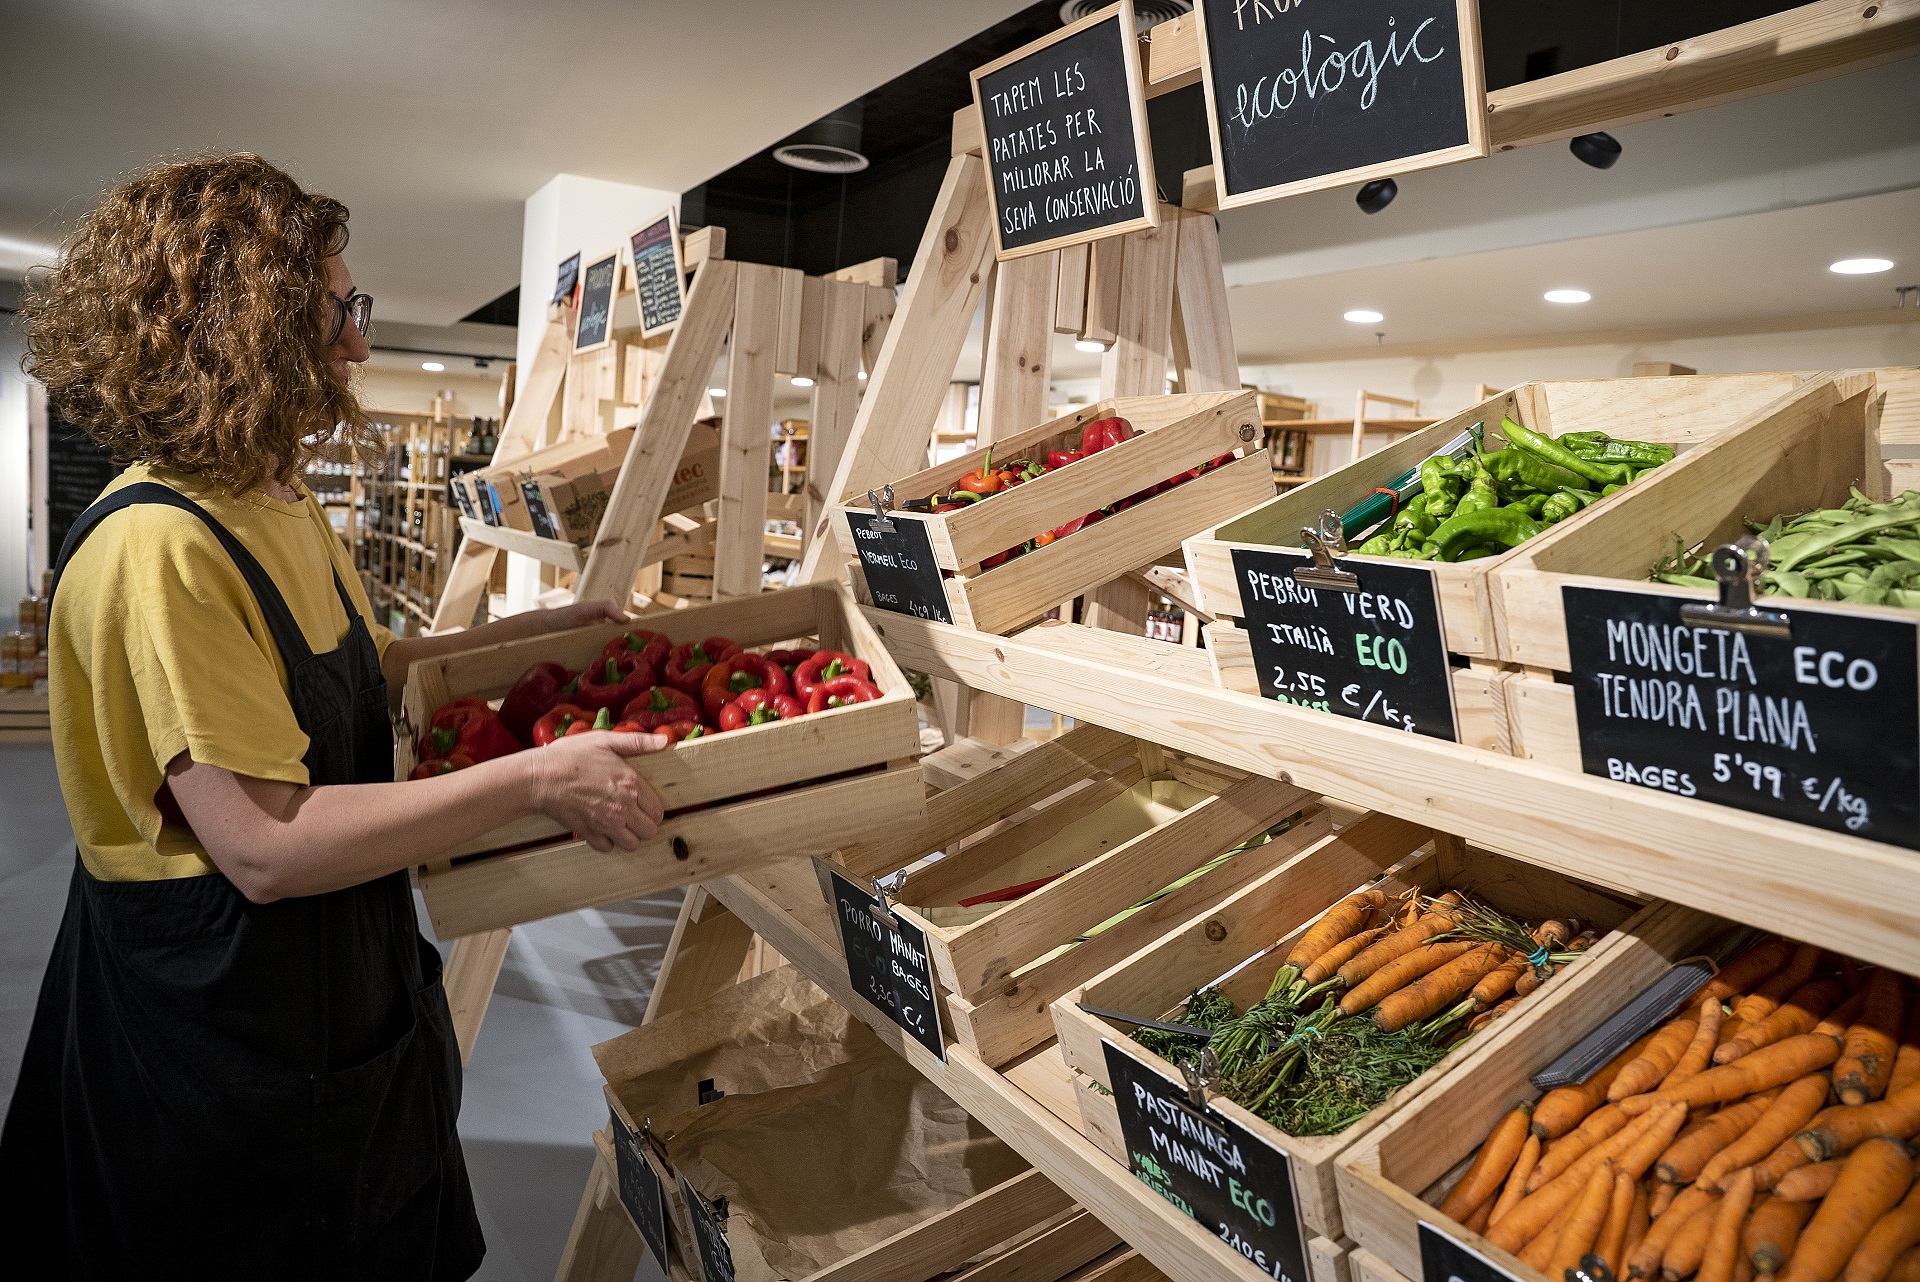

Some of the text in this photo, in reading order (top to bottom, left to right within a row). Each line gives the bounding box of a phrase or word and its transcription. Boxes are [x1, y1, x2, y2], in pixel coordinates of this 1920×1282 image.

[990, 62, 1085, 117] TAPEM LES
[1230, 16, 1444, 127] ecològic
[993, 108, 1102, 163] PATATES PER
[1085, 147, 1105, 172] LA
[1004, 201, 1037, 234] SEVA
[876, 590, 898, 604] BAGES
[1342, 592, 1414, 630] VERD
[1356, 633, 1408, 675] ECO
[1606, 618, 1878, 691] MONGETA ECO
[1272, 666, 1326, 698] 2,55
[1596, 672, 1817, 754] TENDRA PLANA
[1606, 752, 1869, 830] BAGES 5'99 €/kg
[840, 898, 926, 972] PORRO MANAT
[892, 960, 930, 1001] BAGES
[1132, 1081, 1246, 1176] PASTANAGA
[1148, 1126, 1277, 1228] MANAT ECO
